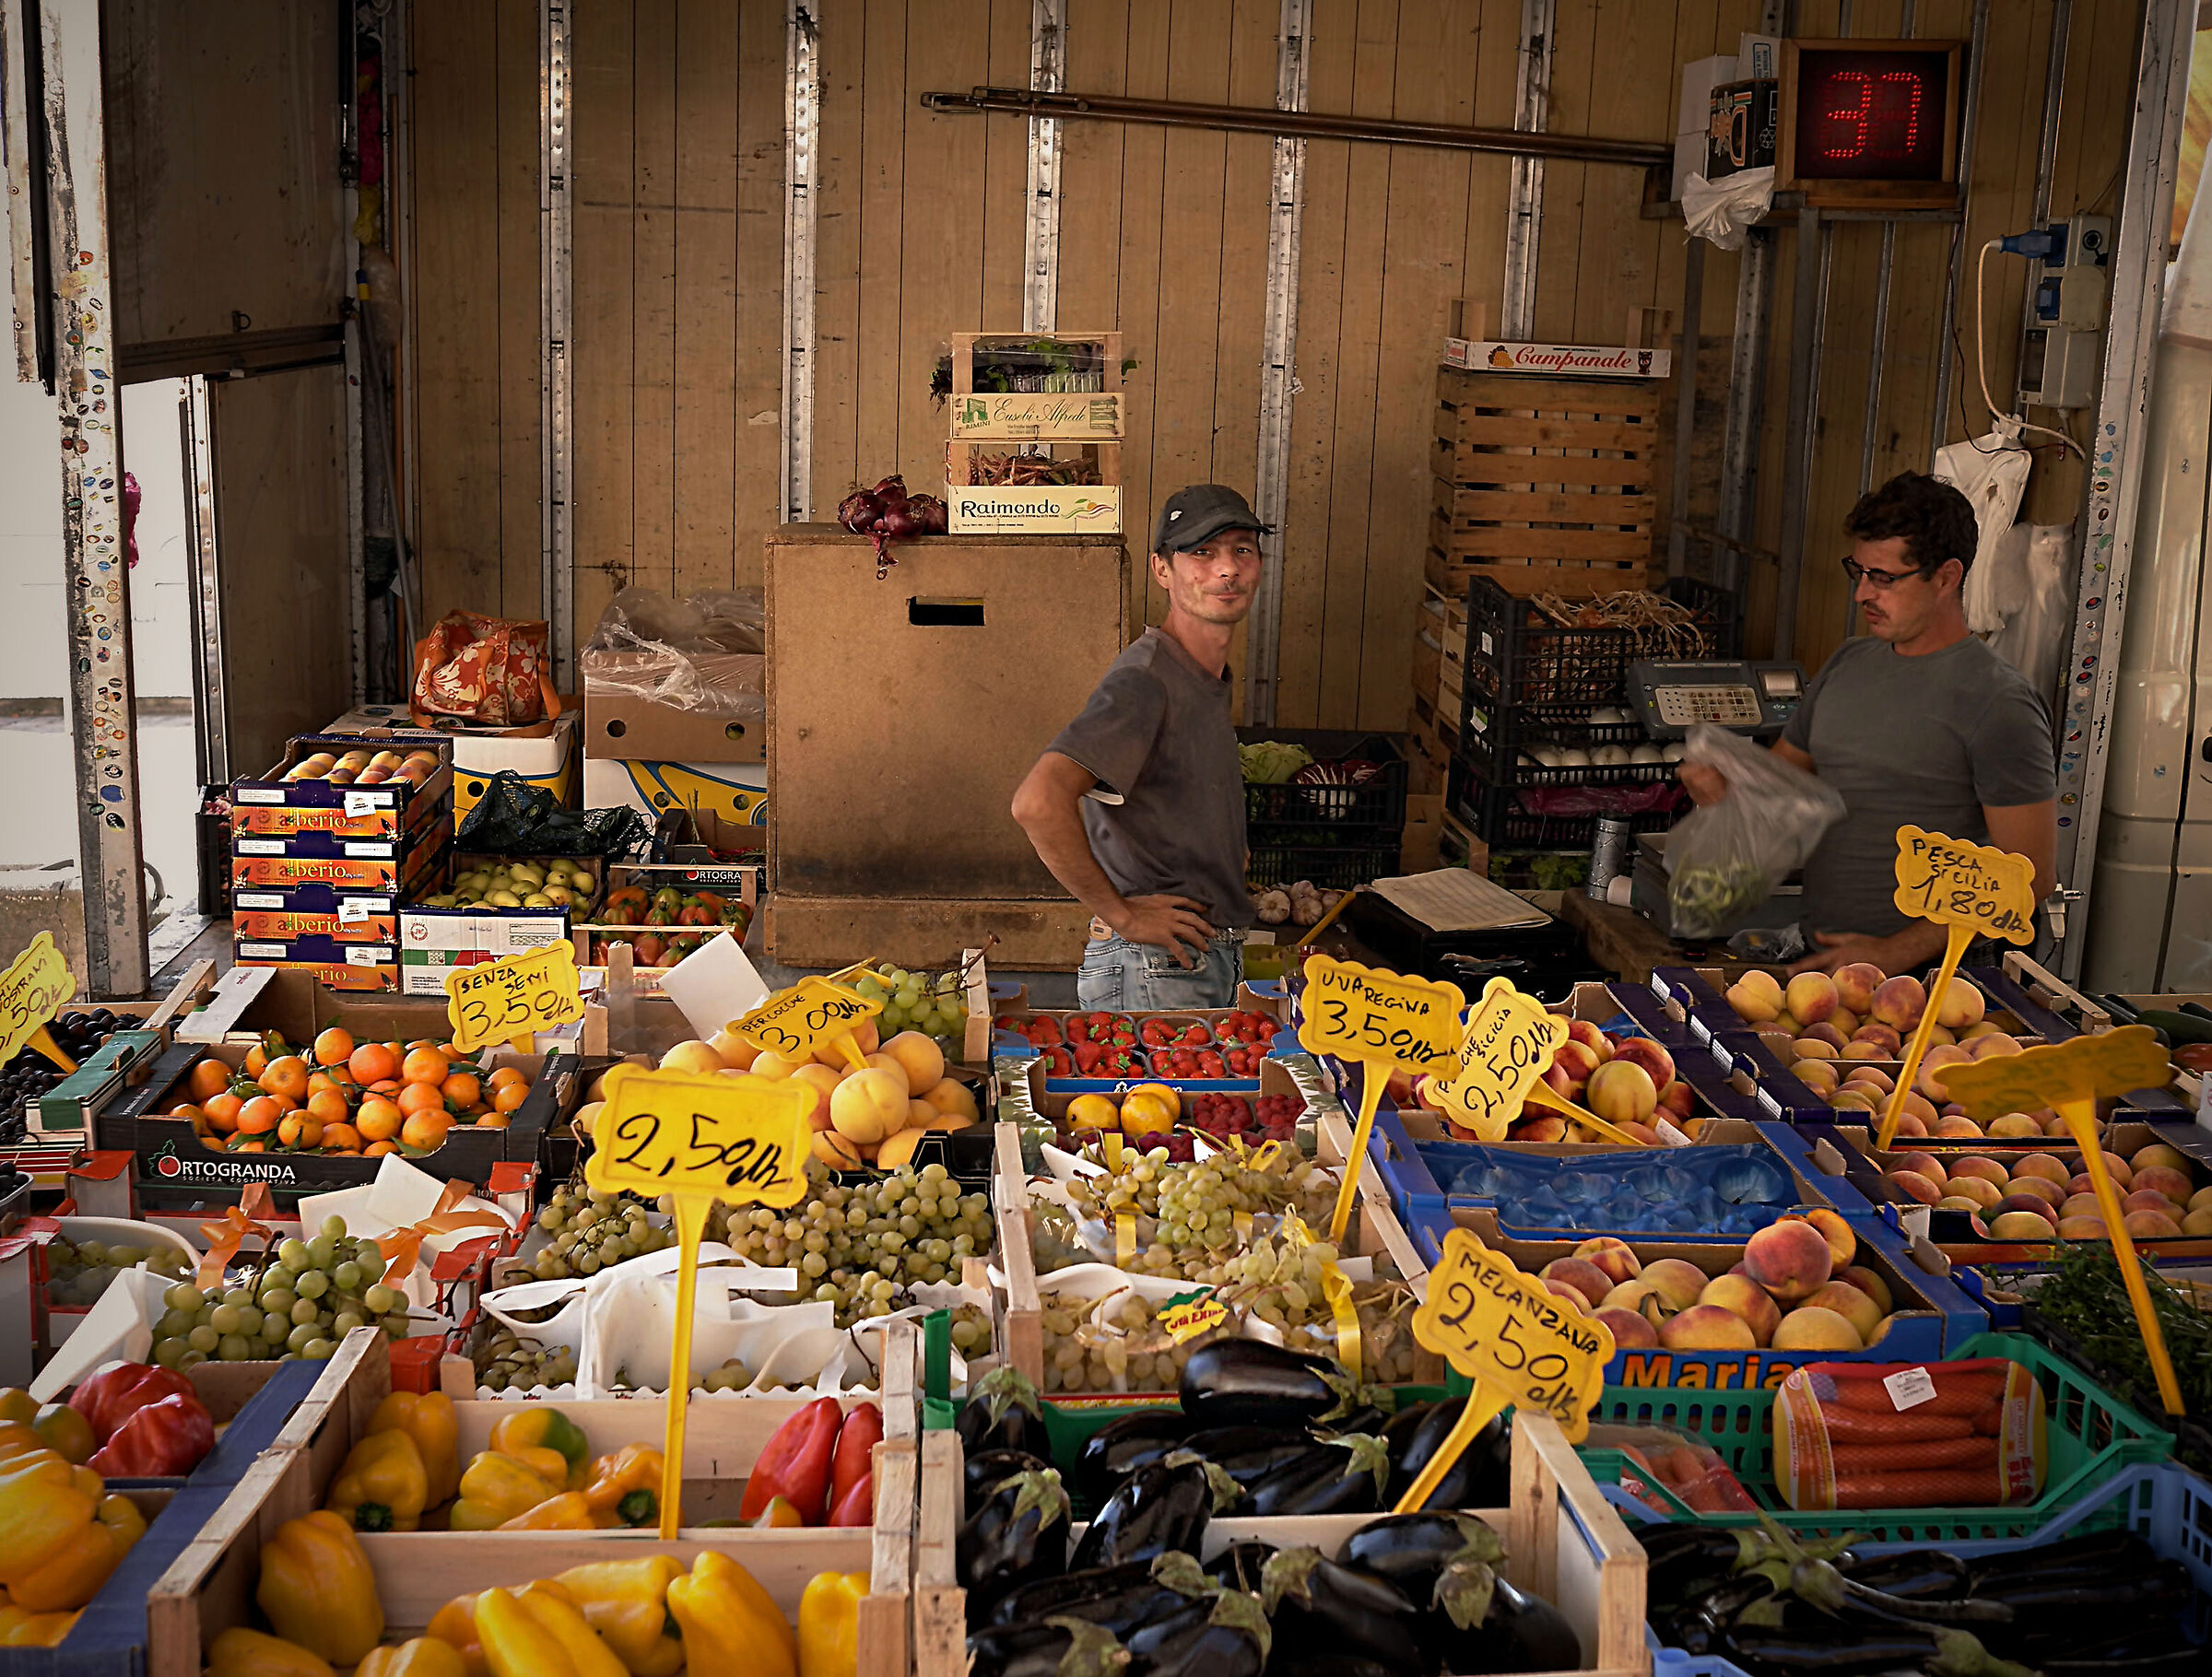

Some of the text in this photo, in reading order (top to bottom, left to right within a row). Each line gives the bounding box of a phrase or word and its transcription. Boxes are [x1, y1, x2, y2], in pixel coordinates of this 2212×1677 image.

[1823, 71, 1923, 158] 37
[1514, 345, 1632, 372] Campanale
[965, 420, 991, 429] RIMINI
[993, 397, 1088, 428] Eusebi Alfredo
[960, 498, 1061, 518] Raimondo
[1912, 838, 1983, 873] PESCA
[1911, 874, 1996, 918] 1,80
[461, 967, 517, 994] SENZA
[462, 991, 558, 1038] 3,50
[759, 1001, 841, 1053] 3,00
[1322, 1000, 1414, 1047] 3,50
[1464, 1035, 1529, 1119] 2,50
[158, 1155, 296, 1179] ORTOGRANDA
[616, 1112, 757, 1177] 2,50
[1459, 1251, 1600, 1356] MELANZANA
[1438, 1282, 1569, 1381] 2,50
